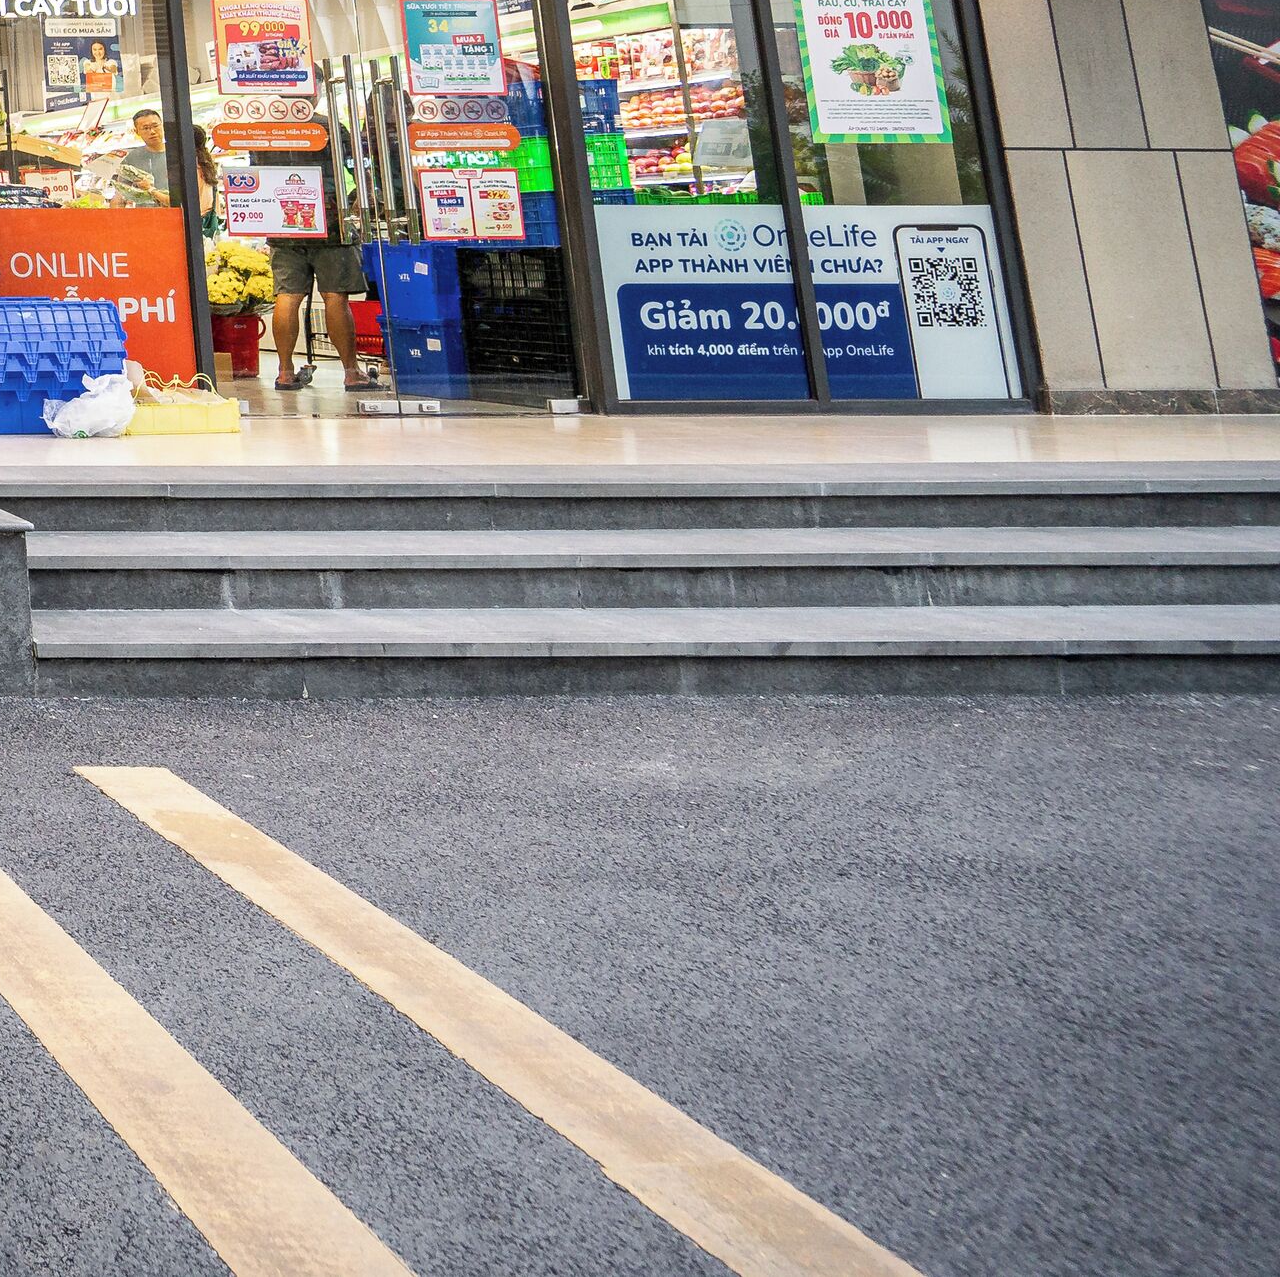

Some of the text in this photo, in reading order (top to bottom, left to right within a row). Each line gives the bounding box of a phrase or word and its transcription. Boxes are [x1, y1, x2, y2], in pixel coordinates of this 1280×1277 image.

[818, 0, 842, 8] RAU,
[239, 21, 286, 37] 99.000
[818, 9, 913, 39] ĐỒNG 10.000
[455, 35, 482, 44] MUA 2
[824, 26, 840, 38] GIÁ
[463, 45, 488, 55] TẶNG
[232, 212, 264, 223] 29.000
[631, 232, 673, 252] BẠN
[677, 227, 708, 247] TẢI
[910, 235, 970, 245] TẢI APP NGAY
[9, 252, 130, 279] ONLINE
[635, 259, 673, 273] APP
[679, 253, 749, 273] THÀNH
[820, 257, 884, 274] CHƯA?
[120, 289, 177, 323] PHÍ
[640, 300, 740, 330] Giảm
[647, 343, 895, 357] khi tích 4,000 điểm trên OneLife
